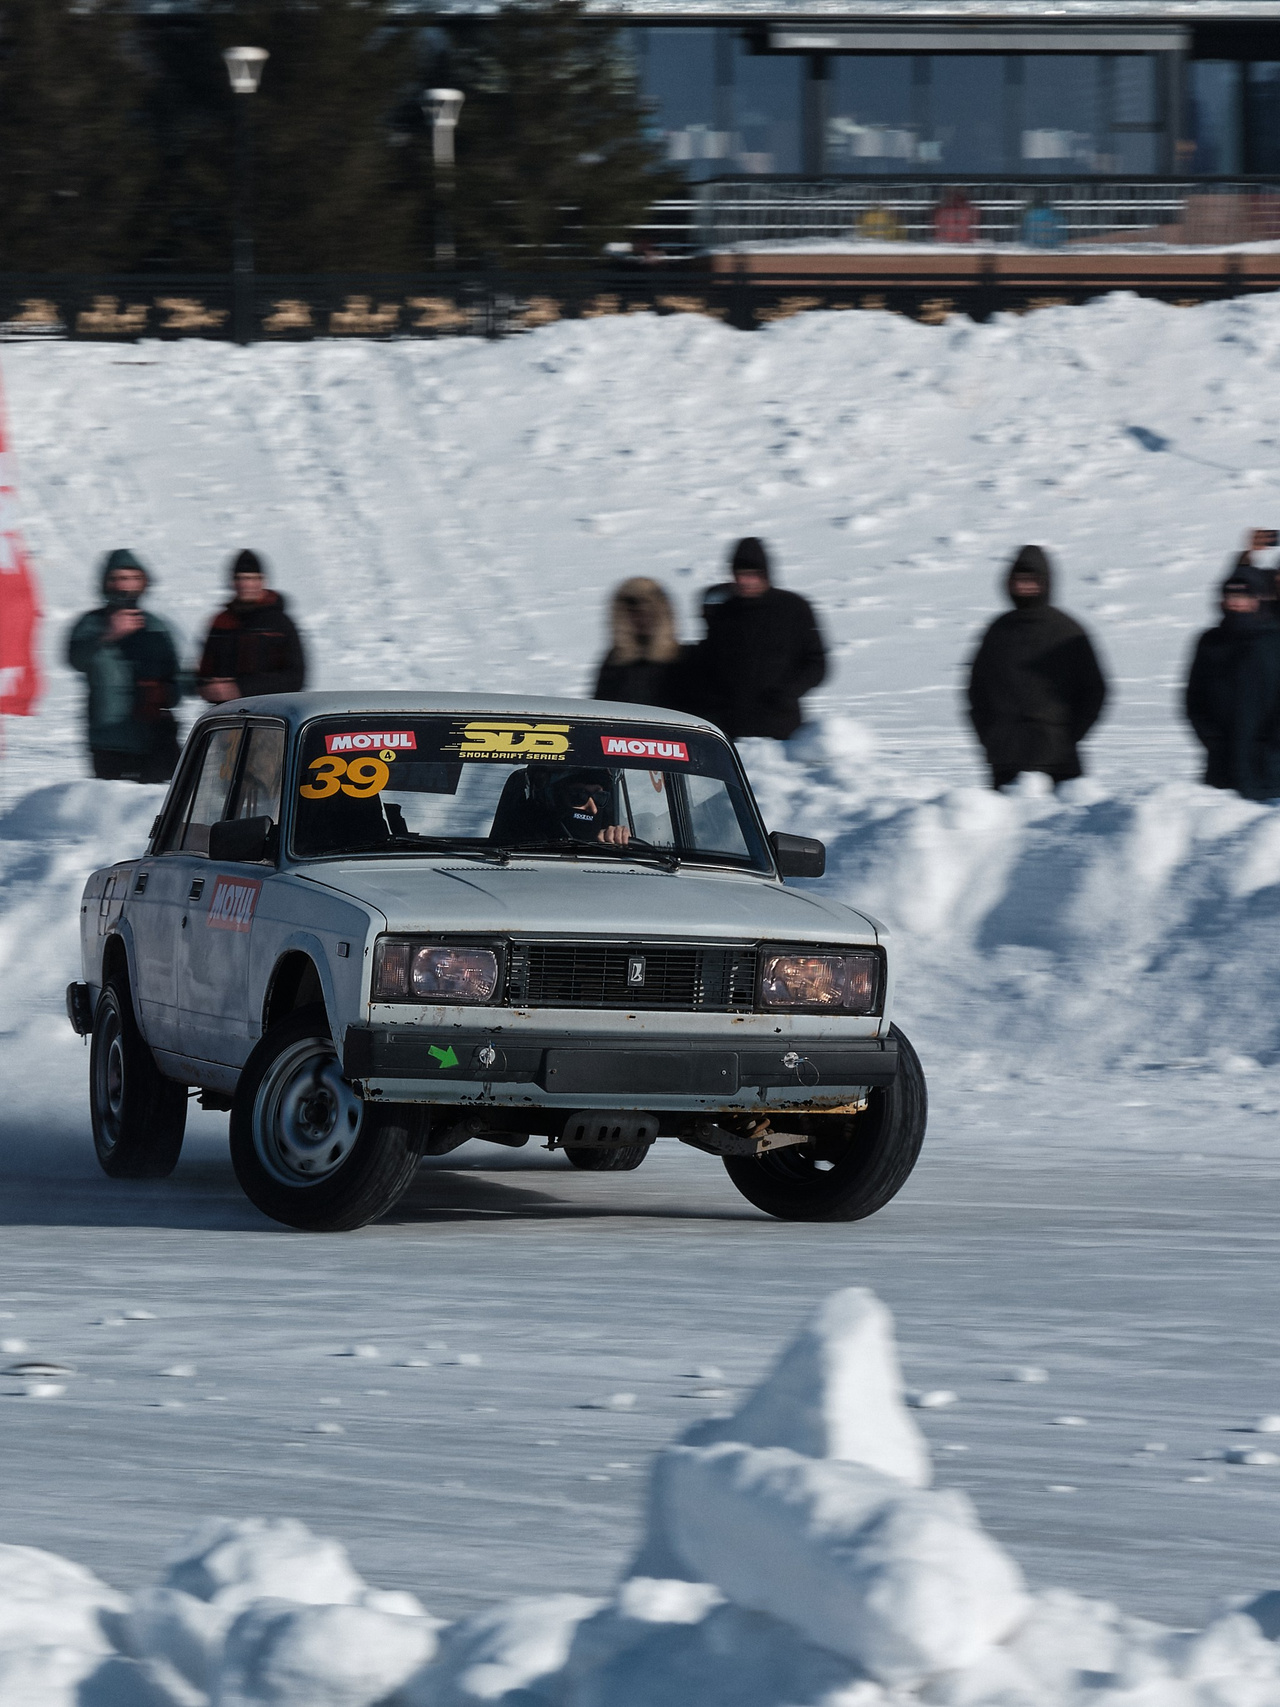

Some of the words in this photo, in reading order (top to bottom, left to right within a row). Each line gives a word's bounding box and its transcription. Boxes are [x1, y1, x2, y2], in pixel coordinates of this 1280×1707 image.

[330, 733, 413, 751] MOTUL
[606, 738, 687, 760] MOTUL
[458, 751, 490, 759] SNOW
[491, 752, 524, 760] DRIFT
[525, 753, 566, 761] SERIES
[299, 755, 390, 799] 39
[208, 882, 257, 924] MOTUL
